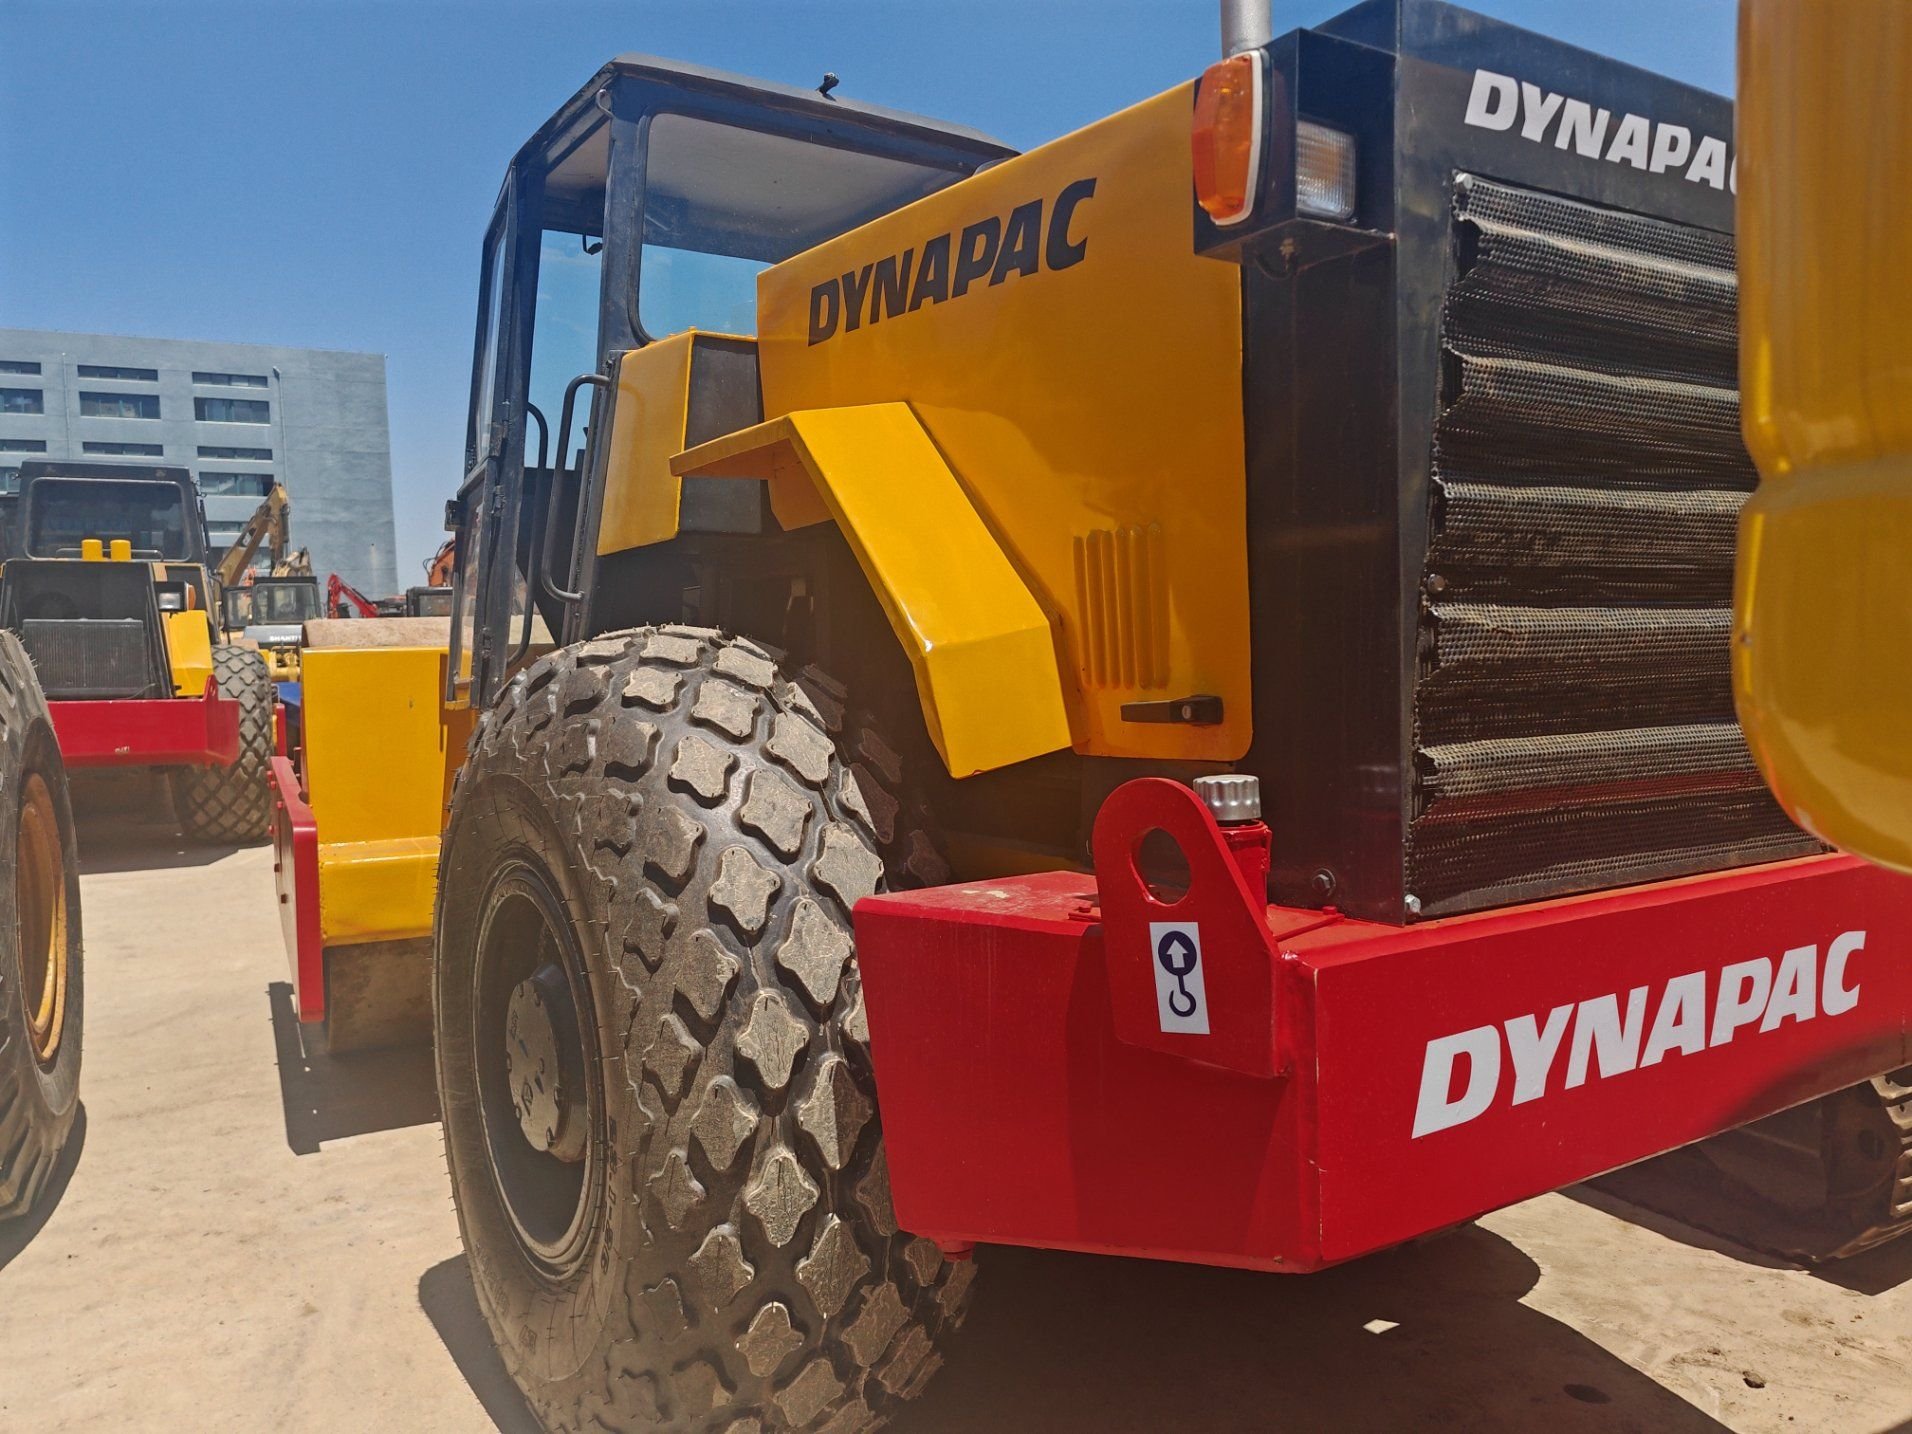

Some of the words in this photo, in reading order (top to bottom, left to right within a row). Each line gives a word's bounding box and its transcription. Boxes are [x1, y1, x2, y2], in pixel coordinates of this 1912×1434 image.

[1464, 69, 1738, 195] DYNAPA
[808, 177, 1097, 347] DYNAPAC
[1411, 930, 1866, 1139] DYNAPAC
